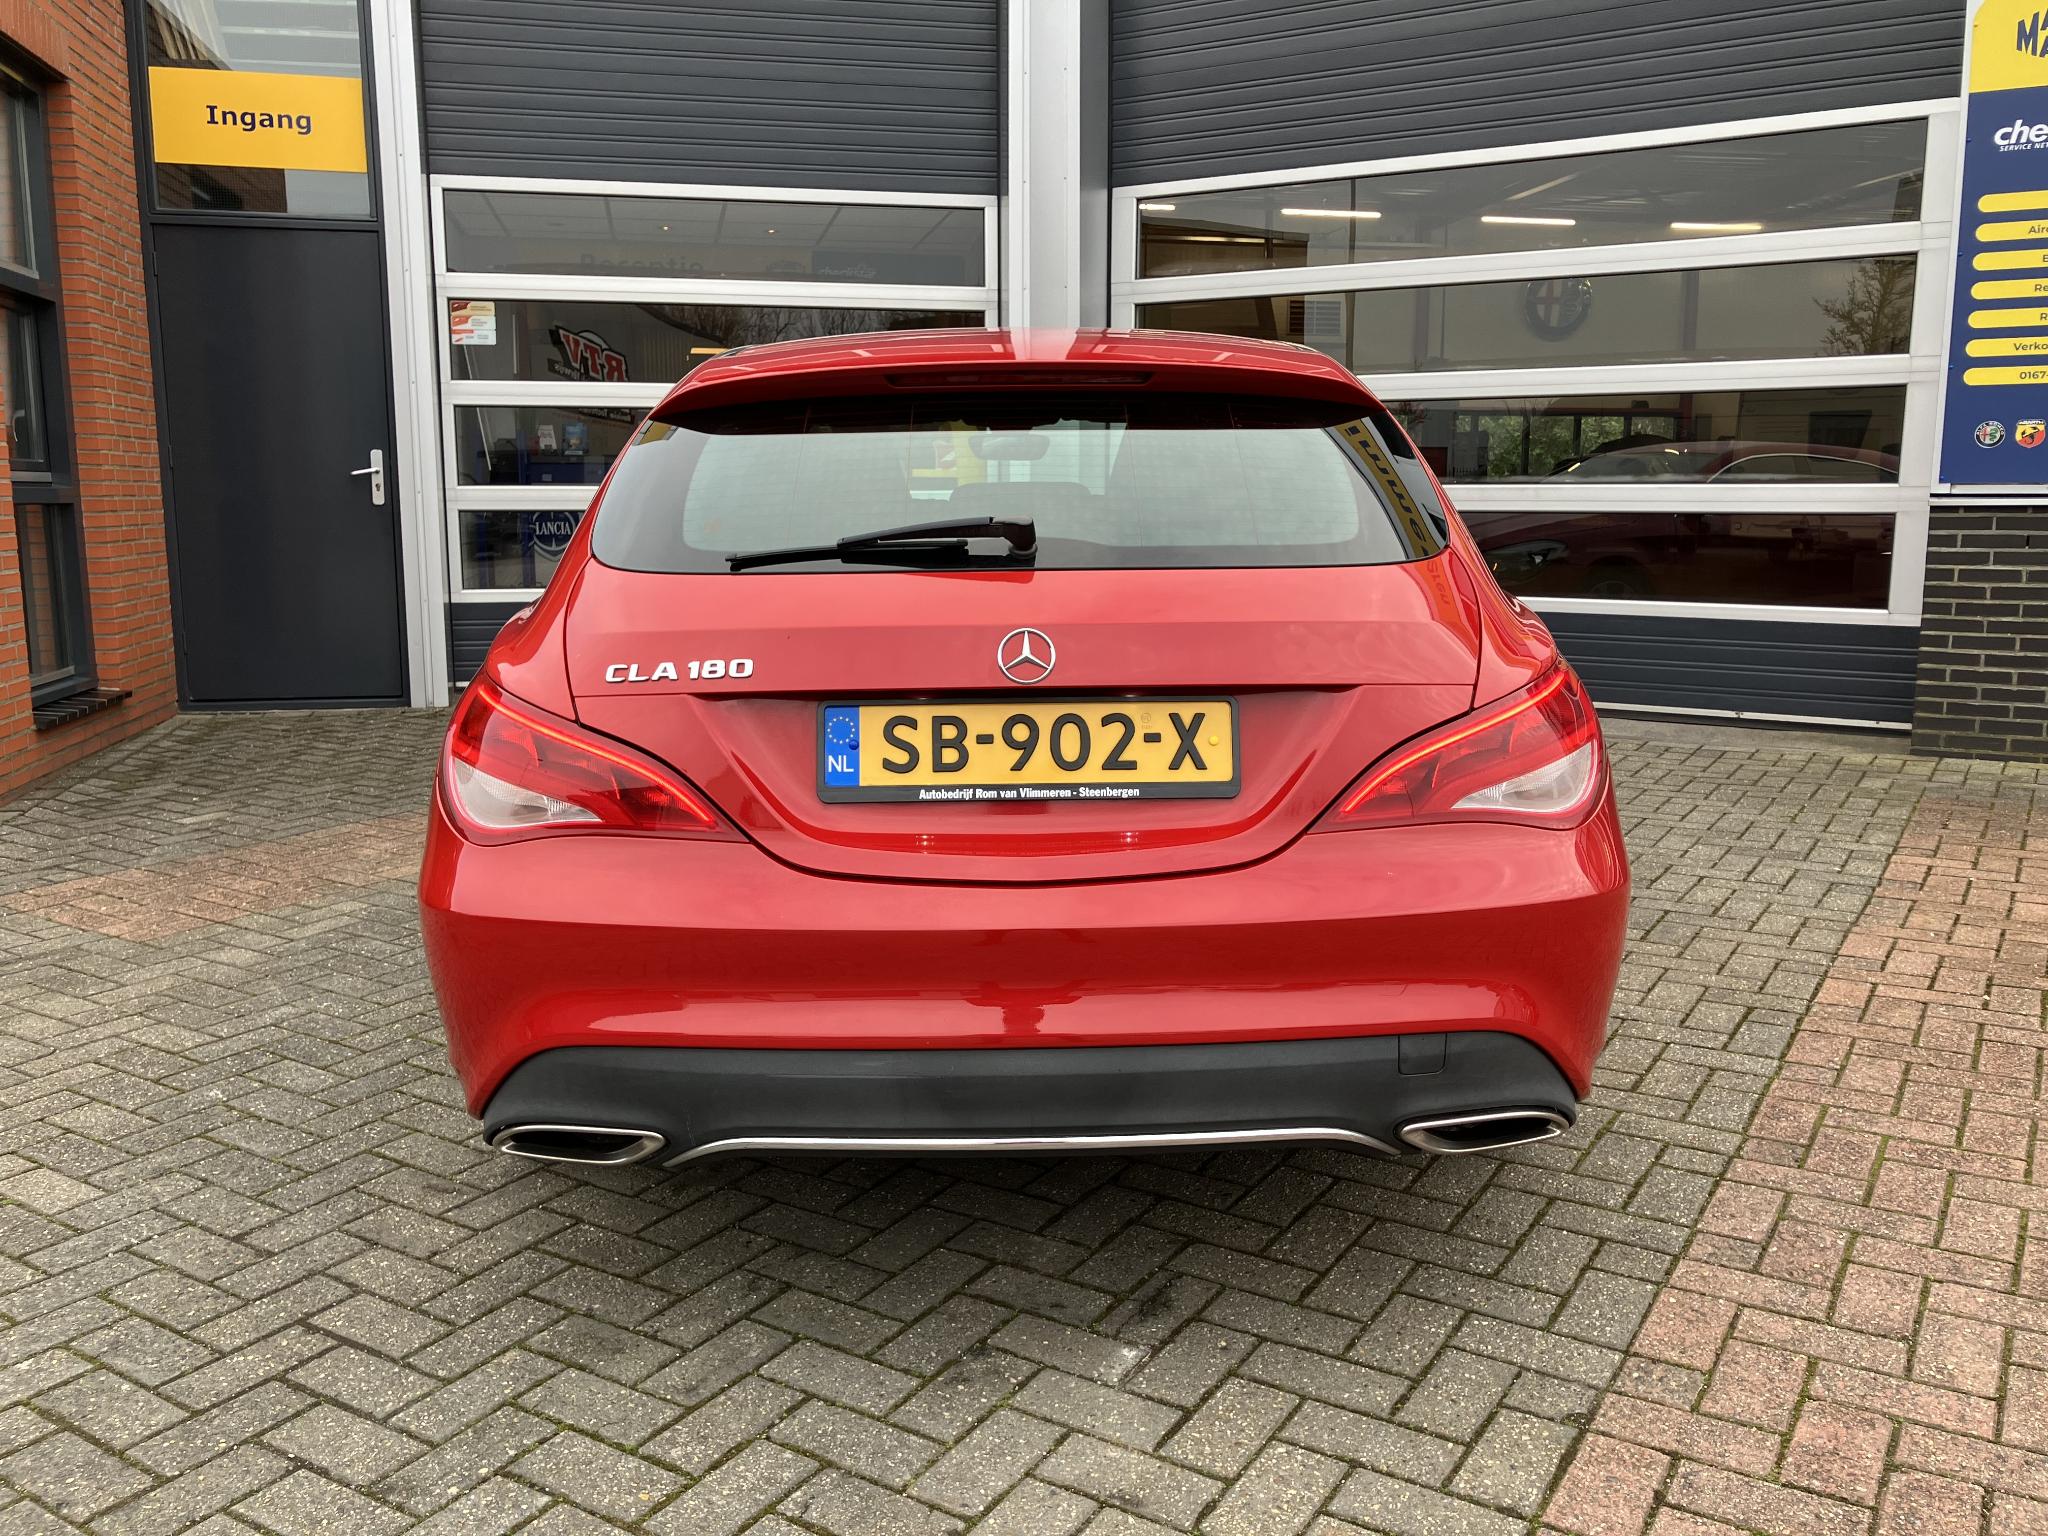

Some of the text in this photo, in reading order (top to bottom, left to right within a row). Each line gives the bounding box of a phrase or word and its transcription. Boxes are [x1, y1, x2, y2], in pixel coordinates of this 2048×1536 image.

[206, 104, 312, 135] Ingang
[2000, 143, 2032, 152] SERVICE
[535, 521, 571, 535] LANCIA
[605, 658, 754, 682] CLA 180
[828, 755, 854, 773] NL
[881, 712, 1208, 774] SB-902-X
[919, 788, 973, 800] Autobedrijf
[976, 788, 997, 799] Rom
[1000, 790, 1017, 799] van
[1020, 787, 1071, 799] Vlimmeren
[1079, 786, 1140, 798] Steenbergen
